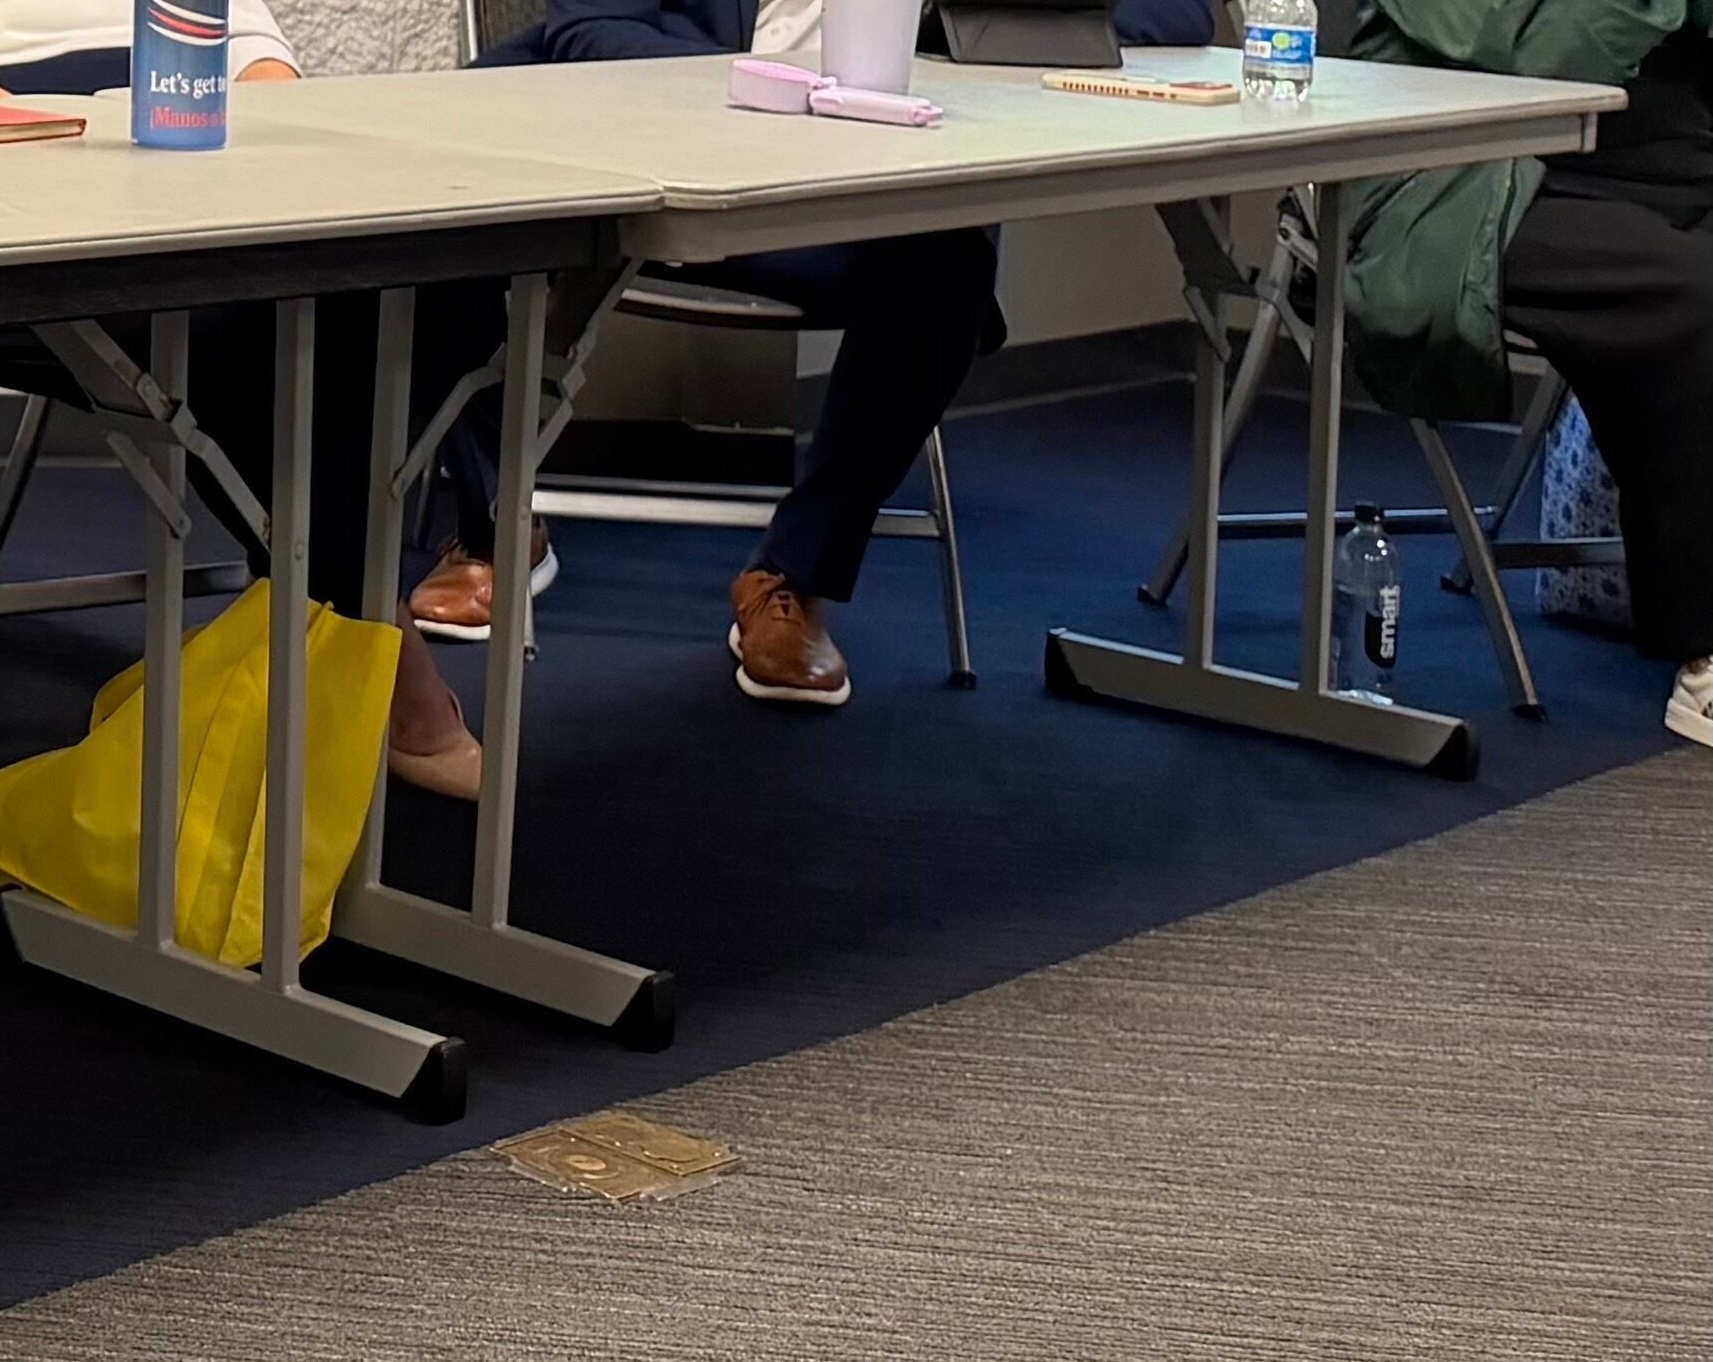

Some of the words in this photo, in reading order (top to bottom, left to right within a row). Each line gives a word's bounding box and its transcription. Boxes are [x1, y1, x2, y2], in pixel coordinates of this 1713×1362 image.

[150, 70, 190, 94] Let's
[193, 75, 215, 99] get
[1379, 585, 1397, 659] smart
